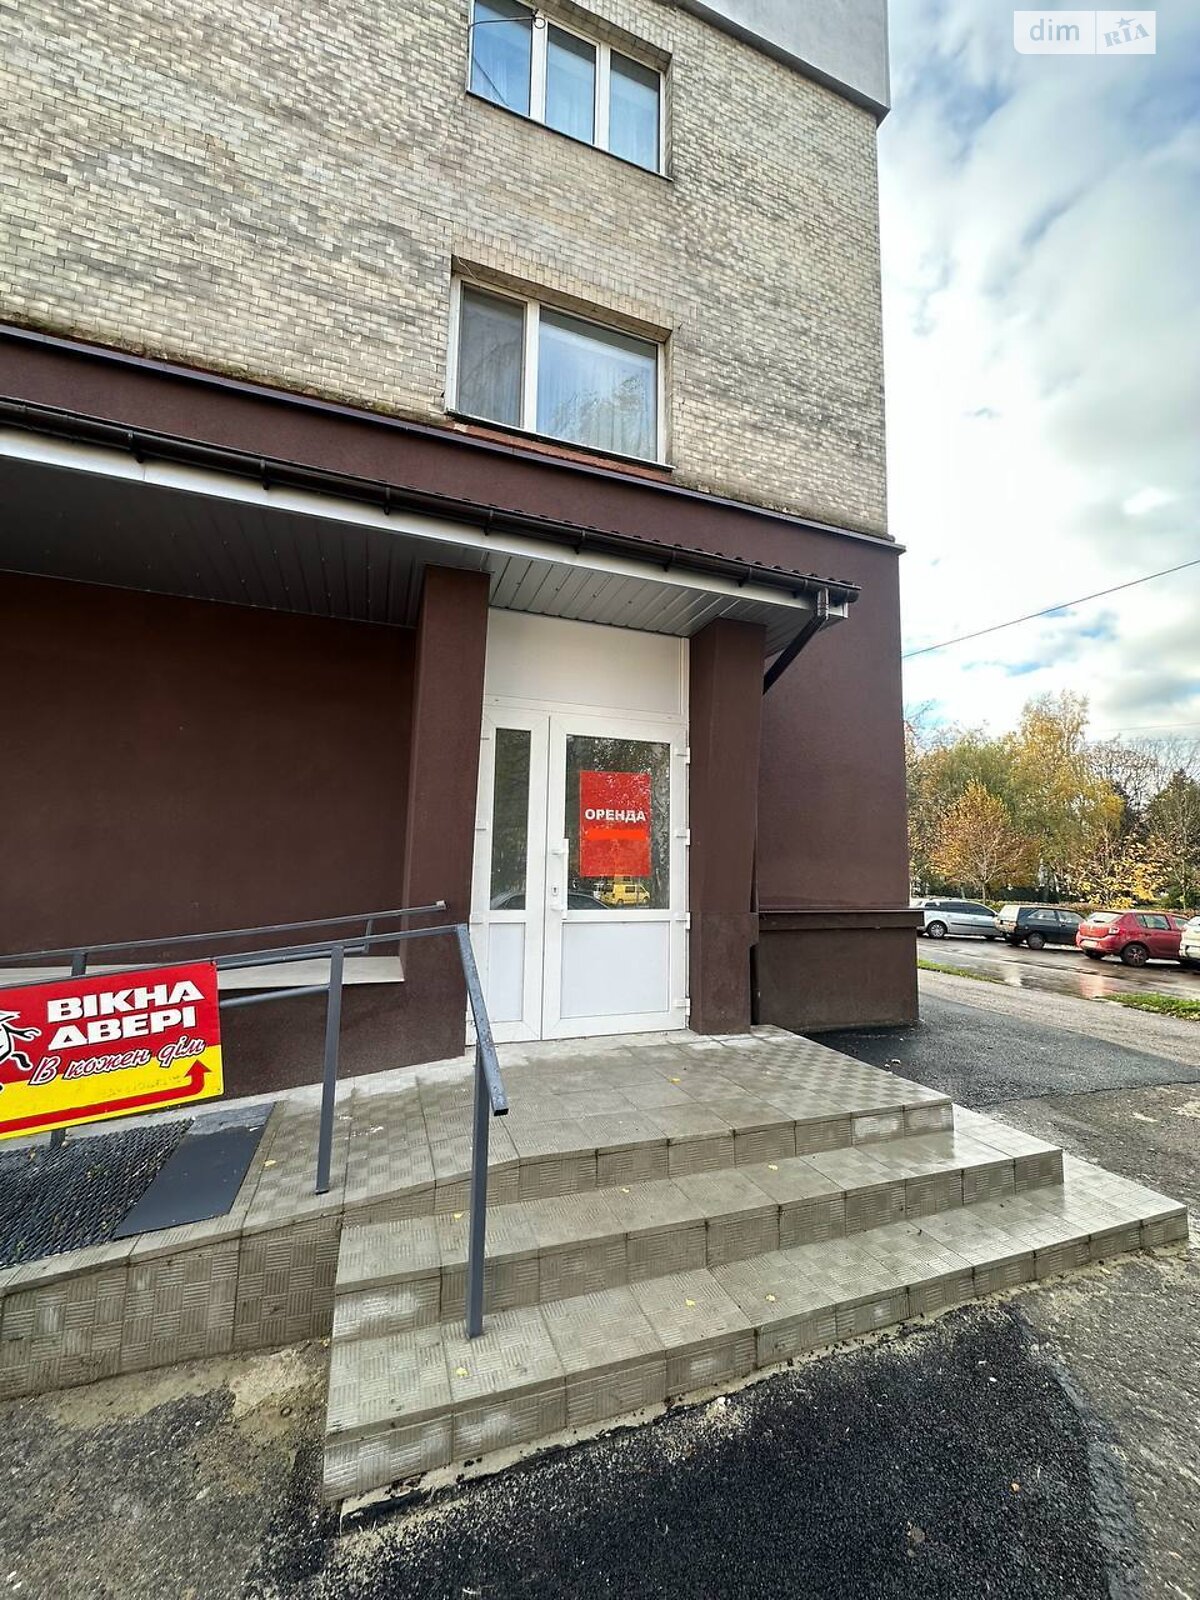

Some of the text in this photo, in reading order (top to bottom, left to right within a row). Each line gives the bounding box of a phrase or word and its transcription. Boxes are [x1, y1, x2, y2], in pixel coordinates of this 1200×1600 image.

[584, 808, 646, 823] ОРЕНДА
[47, 980, 205, 1023] ВІКНА
[48, 1006, 196, 1050] ДВЕРІ
[29, 1035, 206, 1086] В кожен дім
